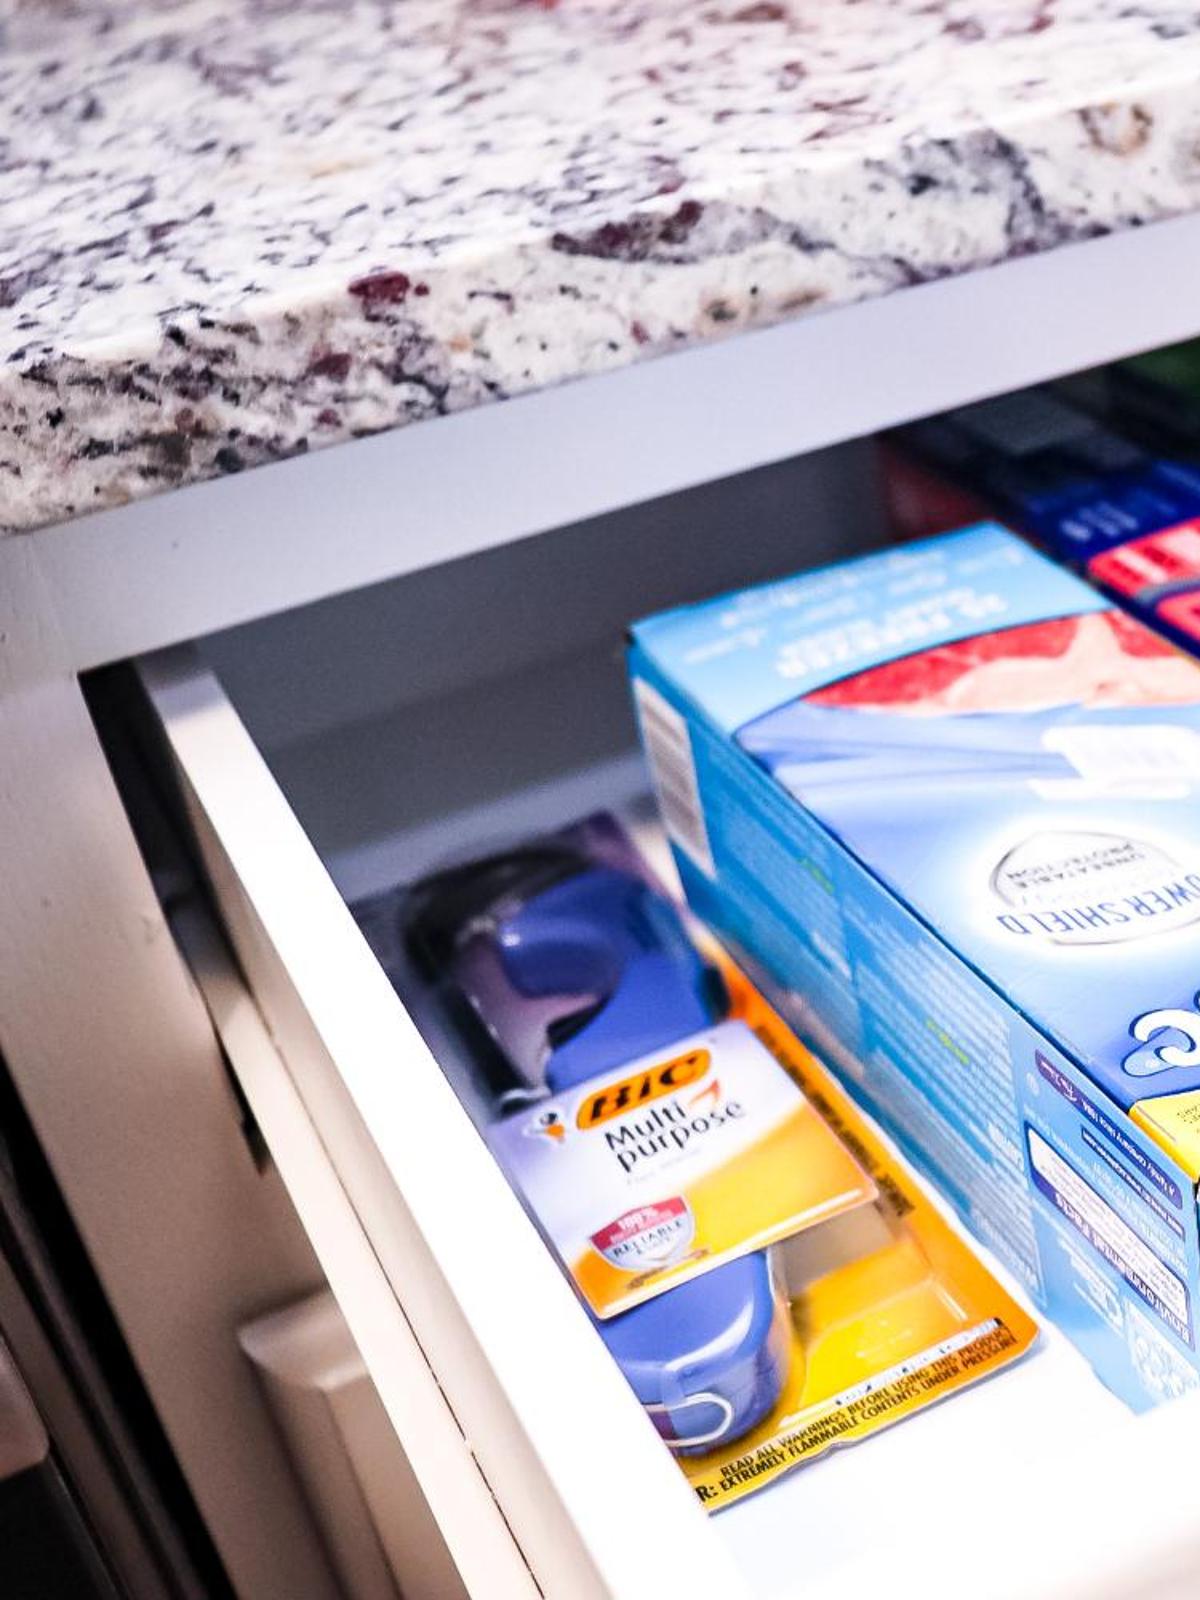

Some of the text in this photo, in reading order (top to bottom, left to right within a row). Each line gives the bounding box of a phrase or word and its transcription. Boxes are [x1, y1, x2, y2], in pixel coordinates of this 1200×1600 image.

[994, 902, 1131, 936] SHIELD
[604, 1100, 687, 1151] Multi
[616, 1101, 746, 1174] purpose
[719, 1451, 787, 1493] EXTREMELY
[788, 1414, 860, 1458] FLAMMABLE
[861, 1384, 921, 1421] CONTENTS
[921, 1366, 960, 1391] UNDER
[720, 1455, 755, 1479] READ
[755, 1442, 778, 1463] ALL
[777, 1410, 846, 1453] WARNINGS
[847, 1390, 890, 1417] BEFORE
[890, 1369, 930, 1393] USING
[931, 1353, 958, 1373] THIS
